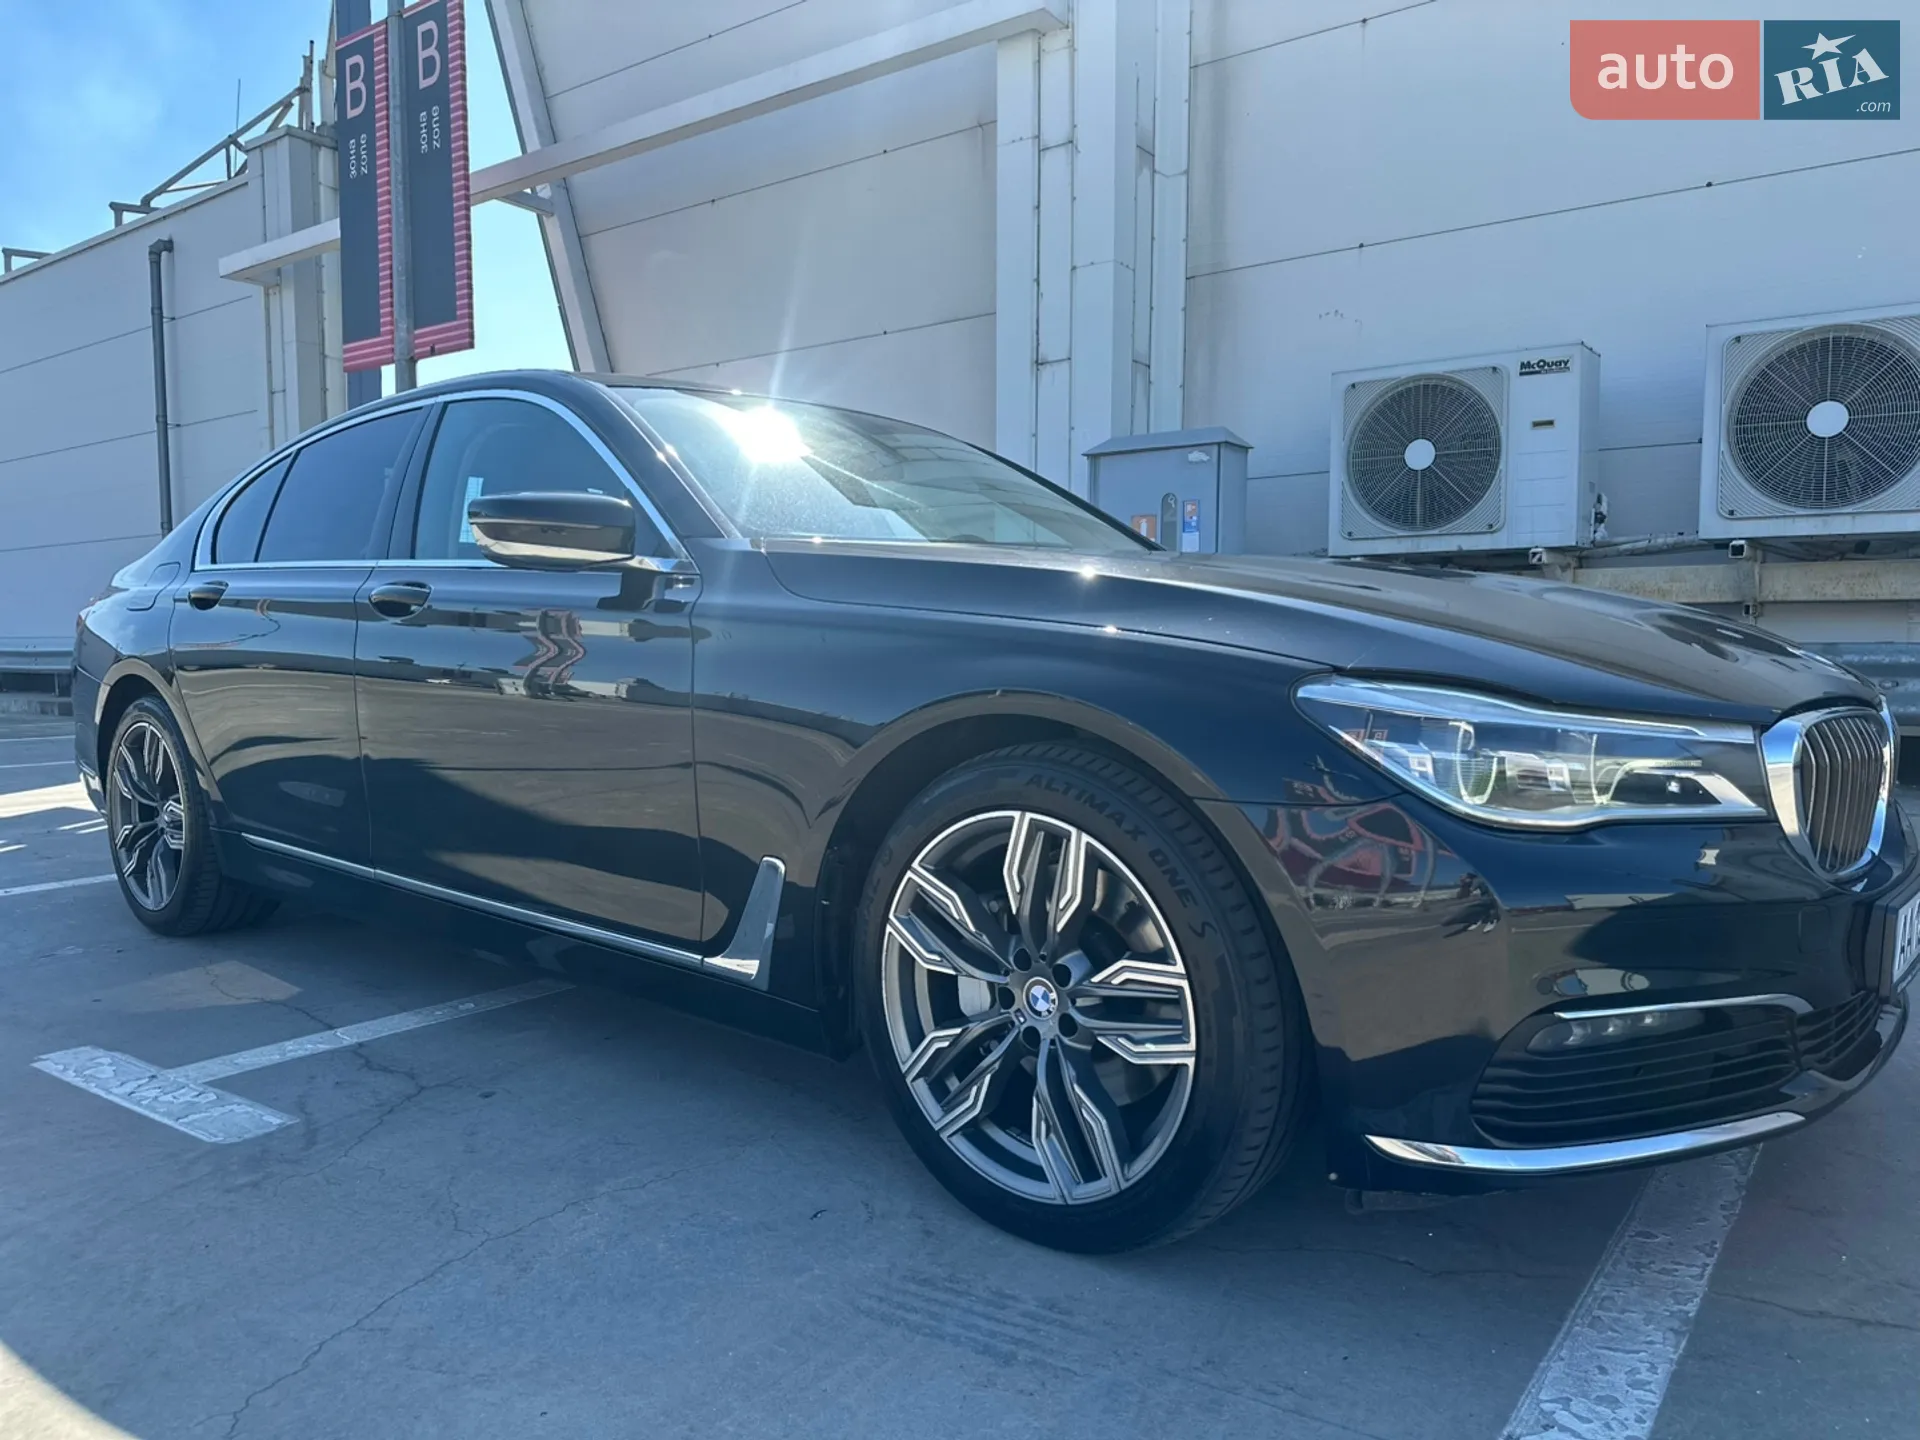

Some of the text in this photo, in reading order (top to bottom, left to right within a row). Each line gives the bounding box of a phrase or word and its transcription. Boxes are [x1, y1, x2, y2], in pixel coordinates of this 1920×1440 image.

[417, 20, 441, 90] B
[345, 54, 367, 119] B
[360, 133, 368, 175] zone
[432, 105, 440, 150] zone
[1520, 359, 1570, 371] McQuay
[1025, 773, 1147, 842] ALTIMAX
[1148, 848, 1198, 908] ONE
